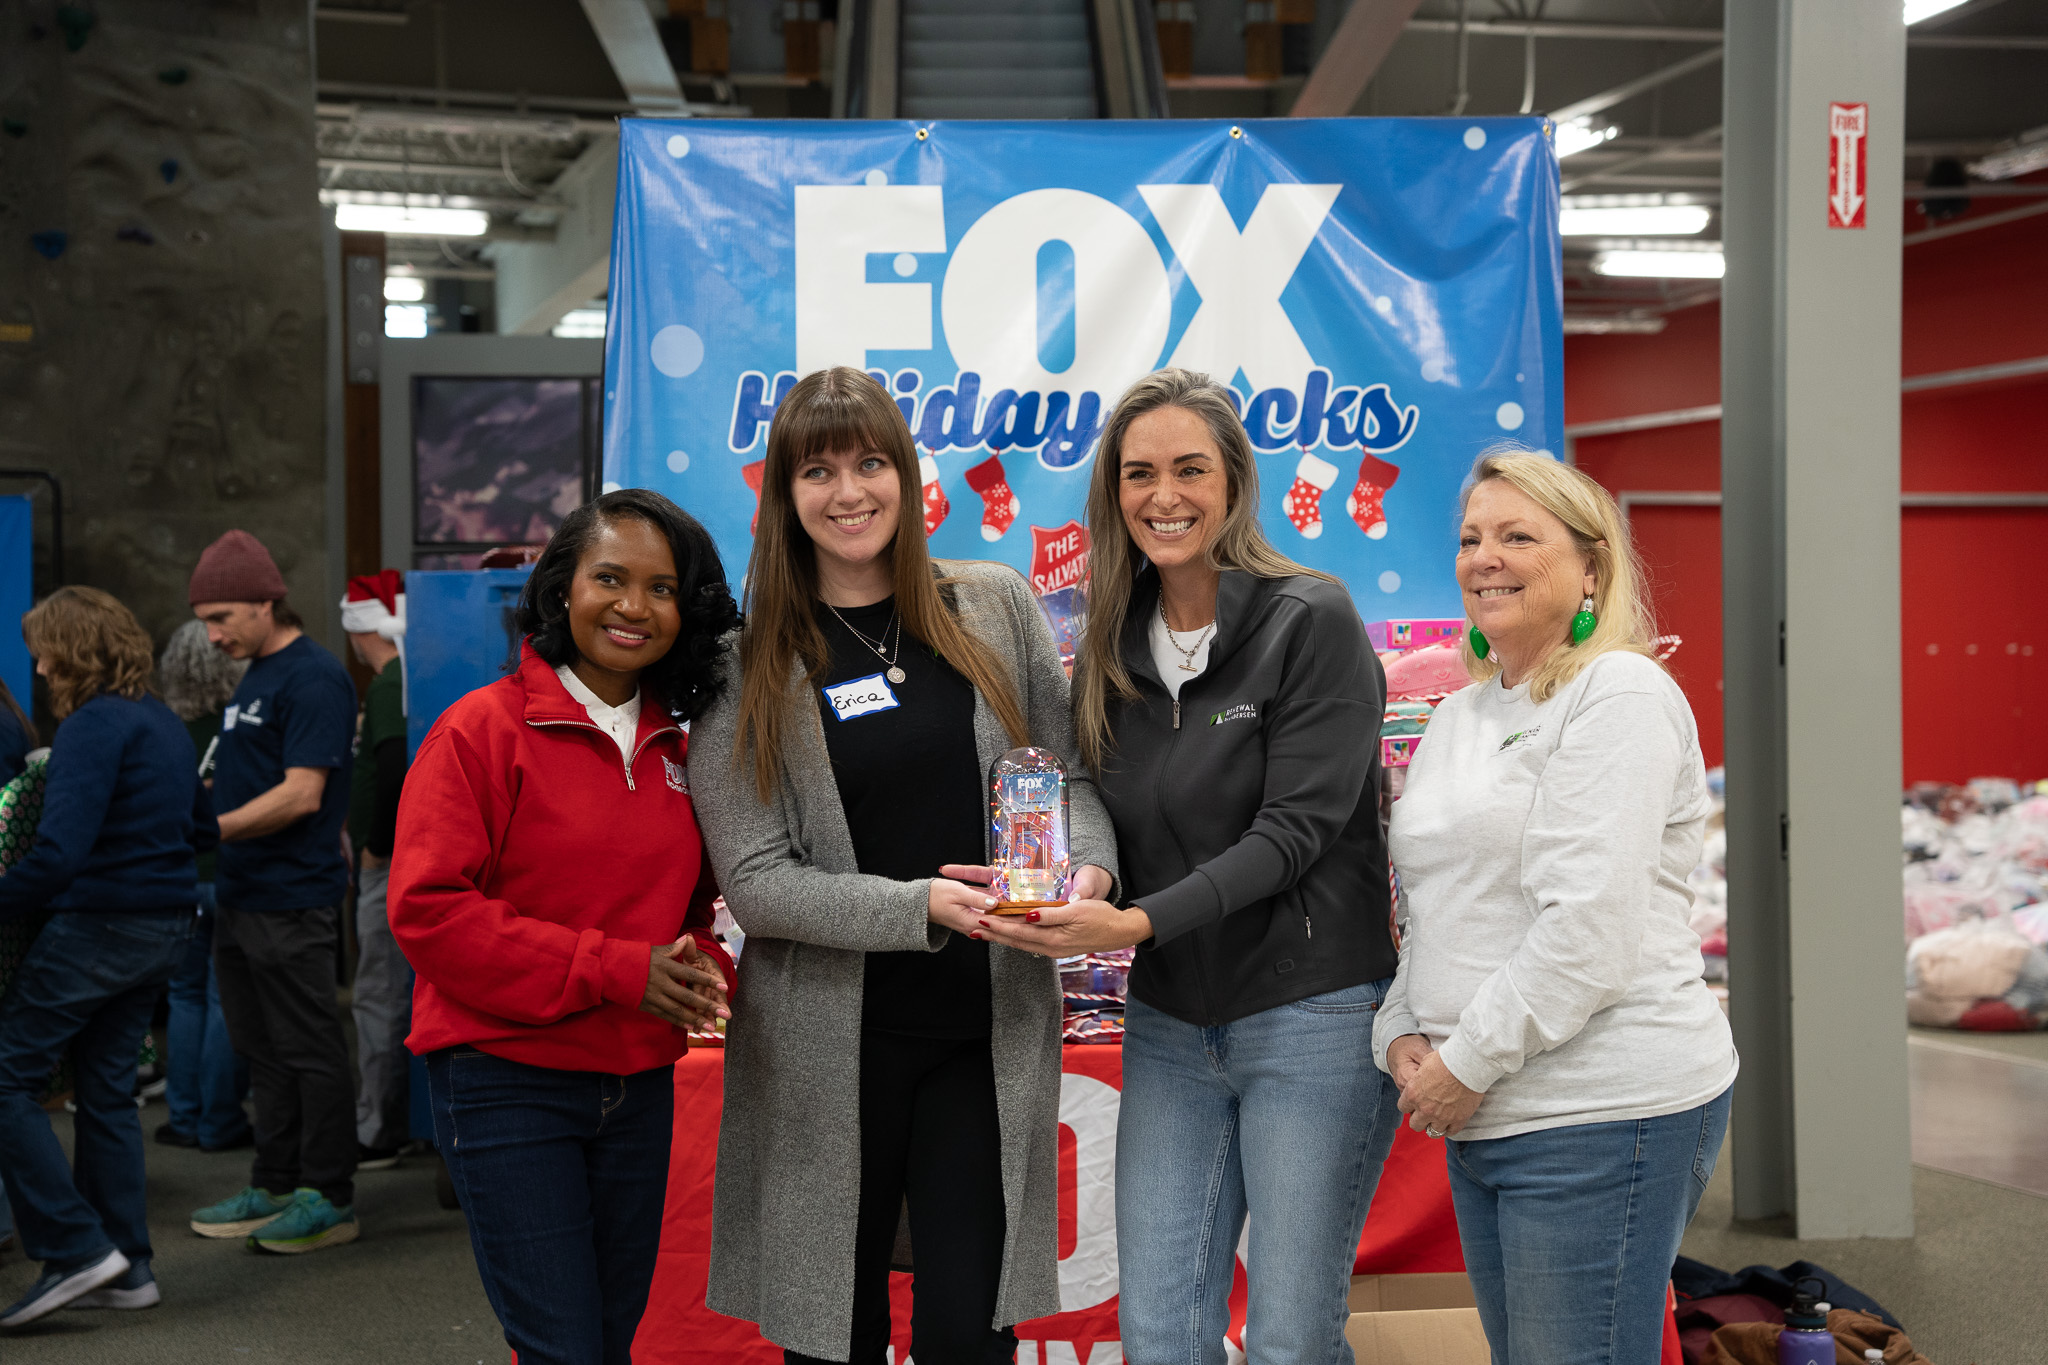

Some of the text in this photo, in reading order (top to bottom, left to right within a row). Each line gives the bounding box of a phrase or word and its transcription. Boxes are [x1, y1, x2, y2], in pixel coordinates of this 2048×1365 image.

[1836, 115, 1859, 131] FIRE
[795, 183, 1343, 389] FOX
[1044, 530, 1080, 563] THE
[833, 692, 885, 710] Erica
[1017, 776, 1044, 790] FOX
